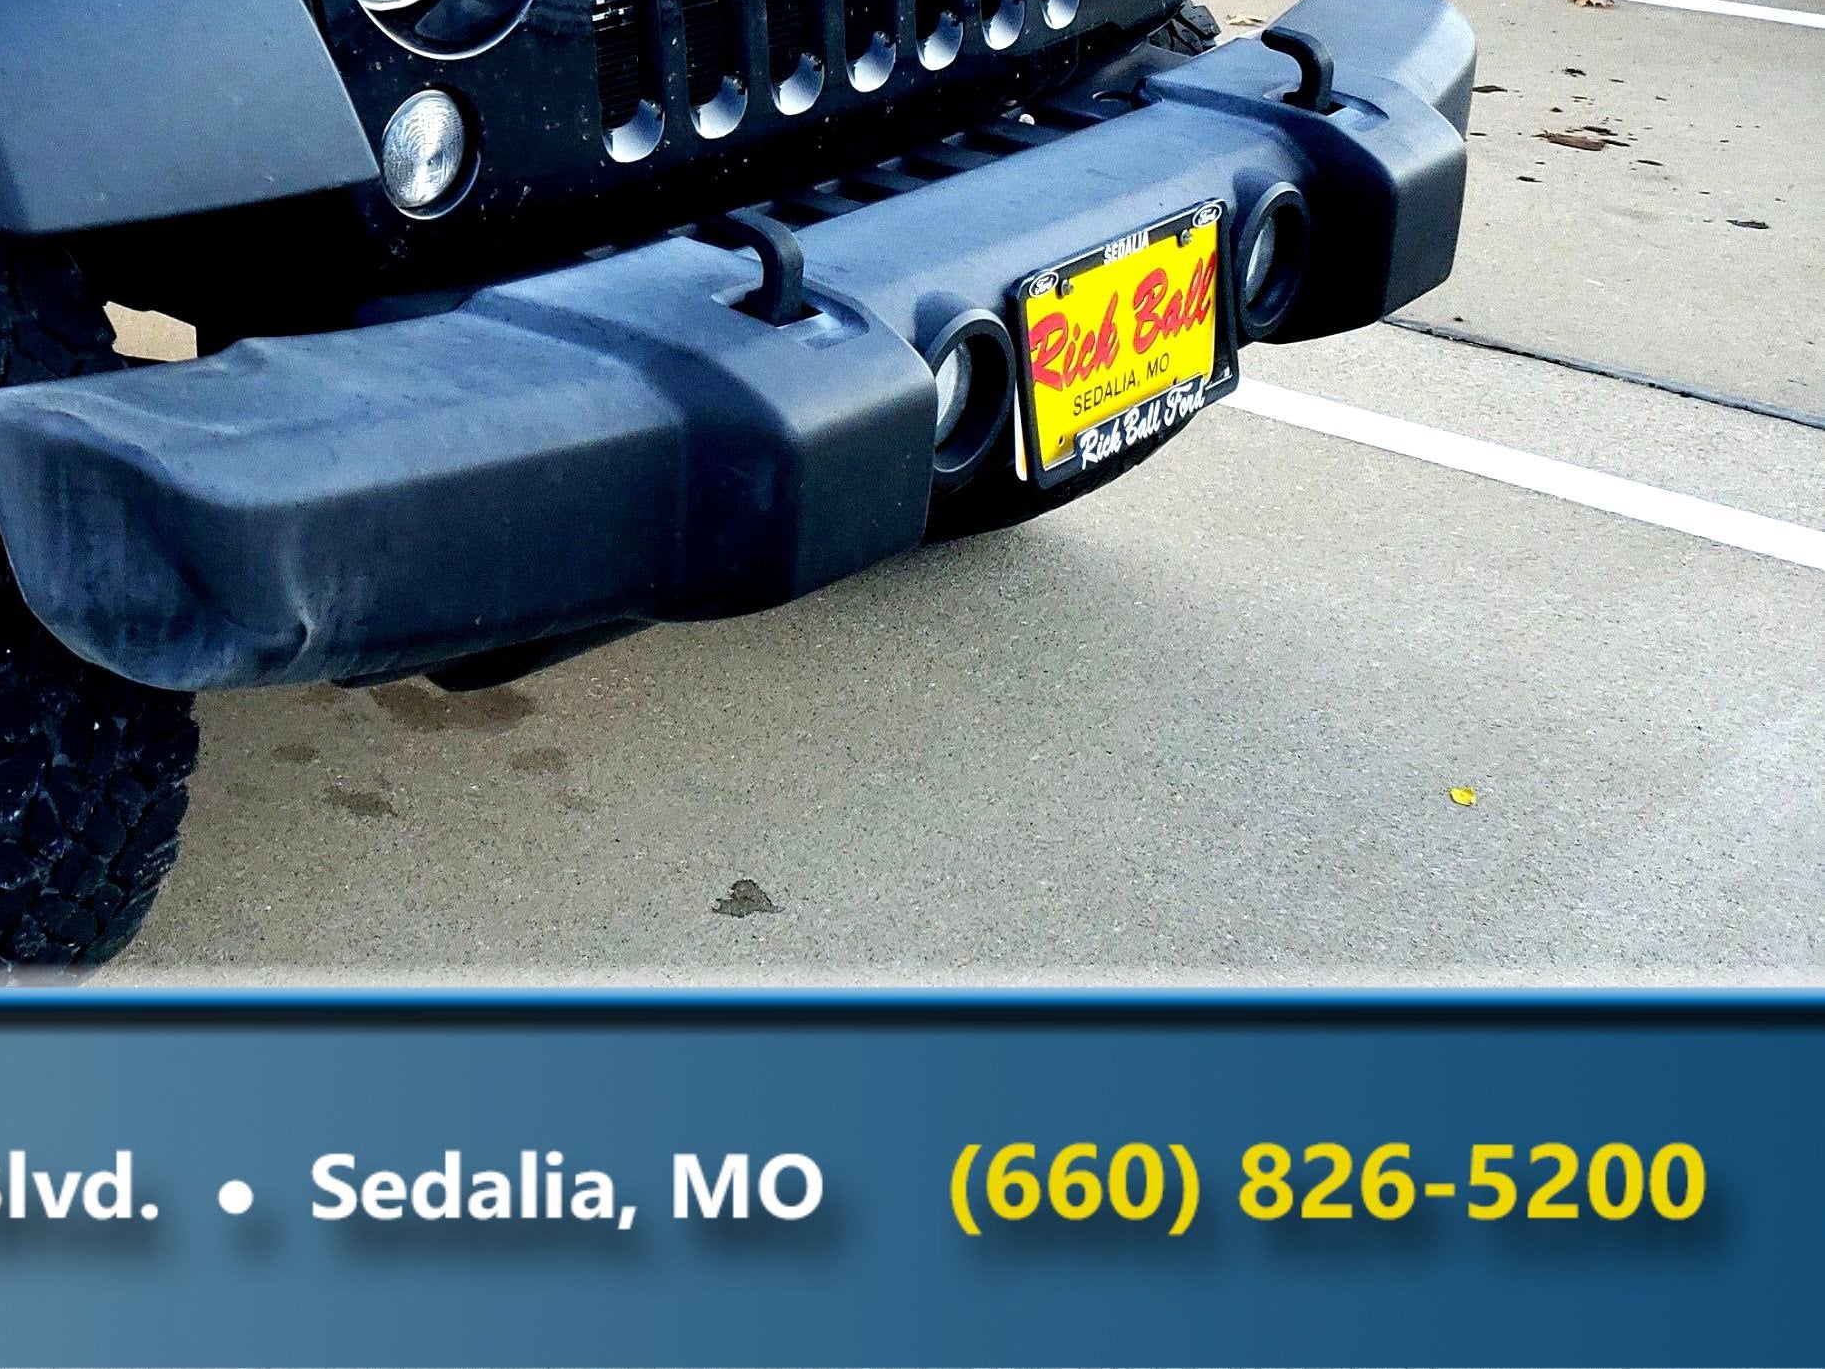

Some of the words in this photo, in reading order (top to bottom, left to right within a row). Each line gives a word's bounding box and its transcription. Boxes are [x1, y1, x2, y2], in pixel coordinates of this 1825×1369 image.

[1103, 231, 1150, 265] SEDALIA
[1029, 290, 1121, 392] Rick
[1132, 248, 1217, 355] Ball
[1073, 369, 1141, 417] SEDALIA,
[1146, 352, 1170, 382] MO
[1079, 419, 1123, 471] Rick
[1123, 398, 1162, 446] Ball
[1163, 378, 1206, 426] Ford
